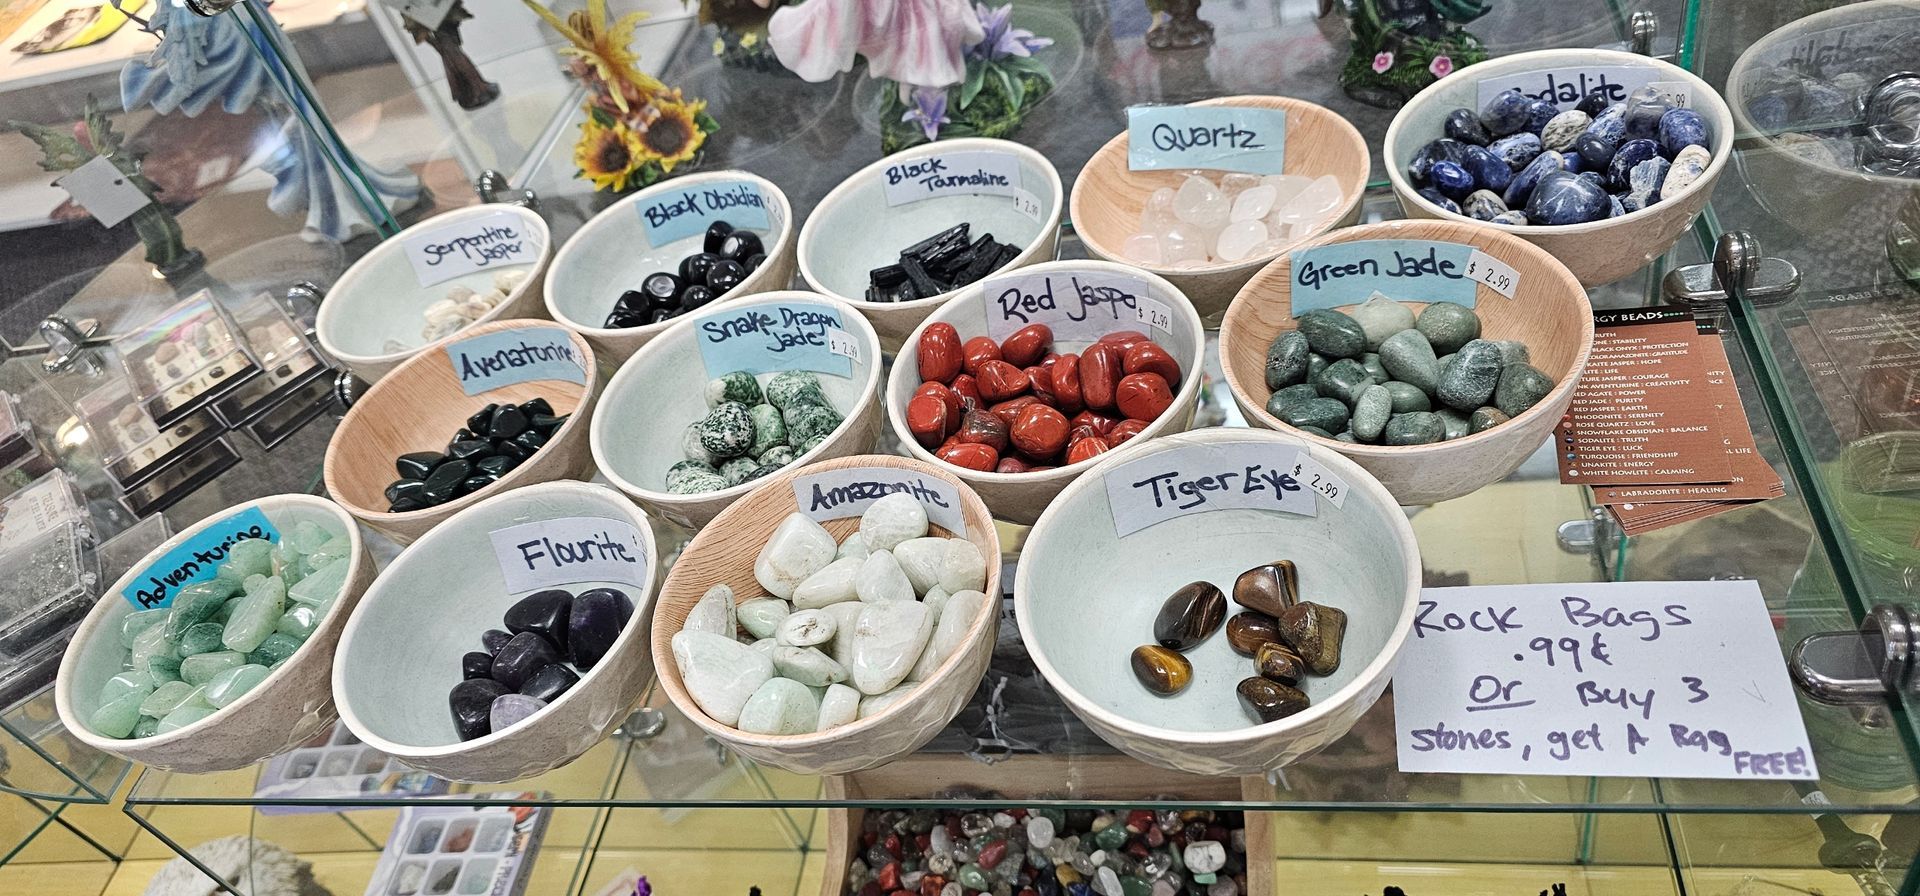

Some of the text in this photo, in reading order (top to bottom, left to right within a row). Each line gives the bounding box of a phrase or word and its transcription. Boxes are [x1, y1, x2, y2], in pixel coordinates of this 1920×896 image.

[1152, 123, 1266, 151] Quartz
[885, 158, 947, 186] Black
[919, 169, 1009, 192] Tourmaline
[644, 192, 704, 228] Black
[703, 185, 765, 211] Obsidian
[1298, 247, 1464, 290] Green Jade
[1485, 268, 1510, 291] 2.99
[998, 277, 1056, 323] Red
[702, 308, 841, 343] Snake Dragon
[1151, 310, 1168, 329] 2.99
[1621, 311, 1663, 321] BEADS
[767, 327, 825, 352] Jade
[843, 342, 858, 359] 2.99
[1641, 342, 1689, 350] PROTECTION
[1652, 349, 1688, 357] GRATITUDE
[1645, 379, 1690, 387] CREATIVITY
[1670, 425, 1708, 433] BALANCE
[1631, 451, 1679, 459] FRIENDSHIP
[1133, 464, 1301, 509] Tiger Eye
[1311, 473, 1338, 499] 2.99
[1620, 486, 1727, 497] LABRADORITE HEALING
[517, 531, 636, 570] Flourite
[1412, 597, 1692, 641] Rock Bags
[1468, 674, 1710, 719] Or Buy 3
[1548, 724, 1603, 760] get
[1734, 745, 1811, 776] FREE!
